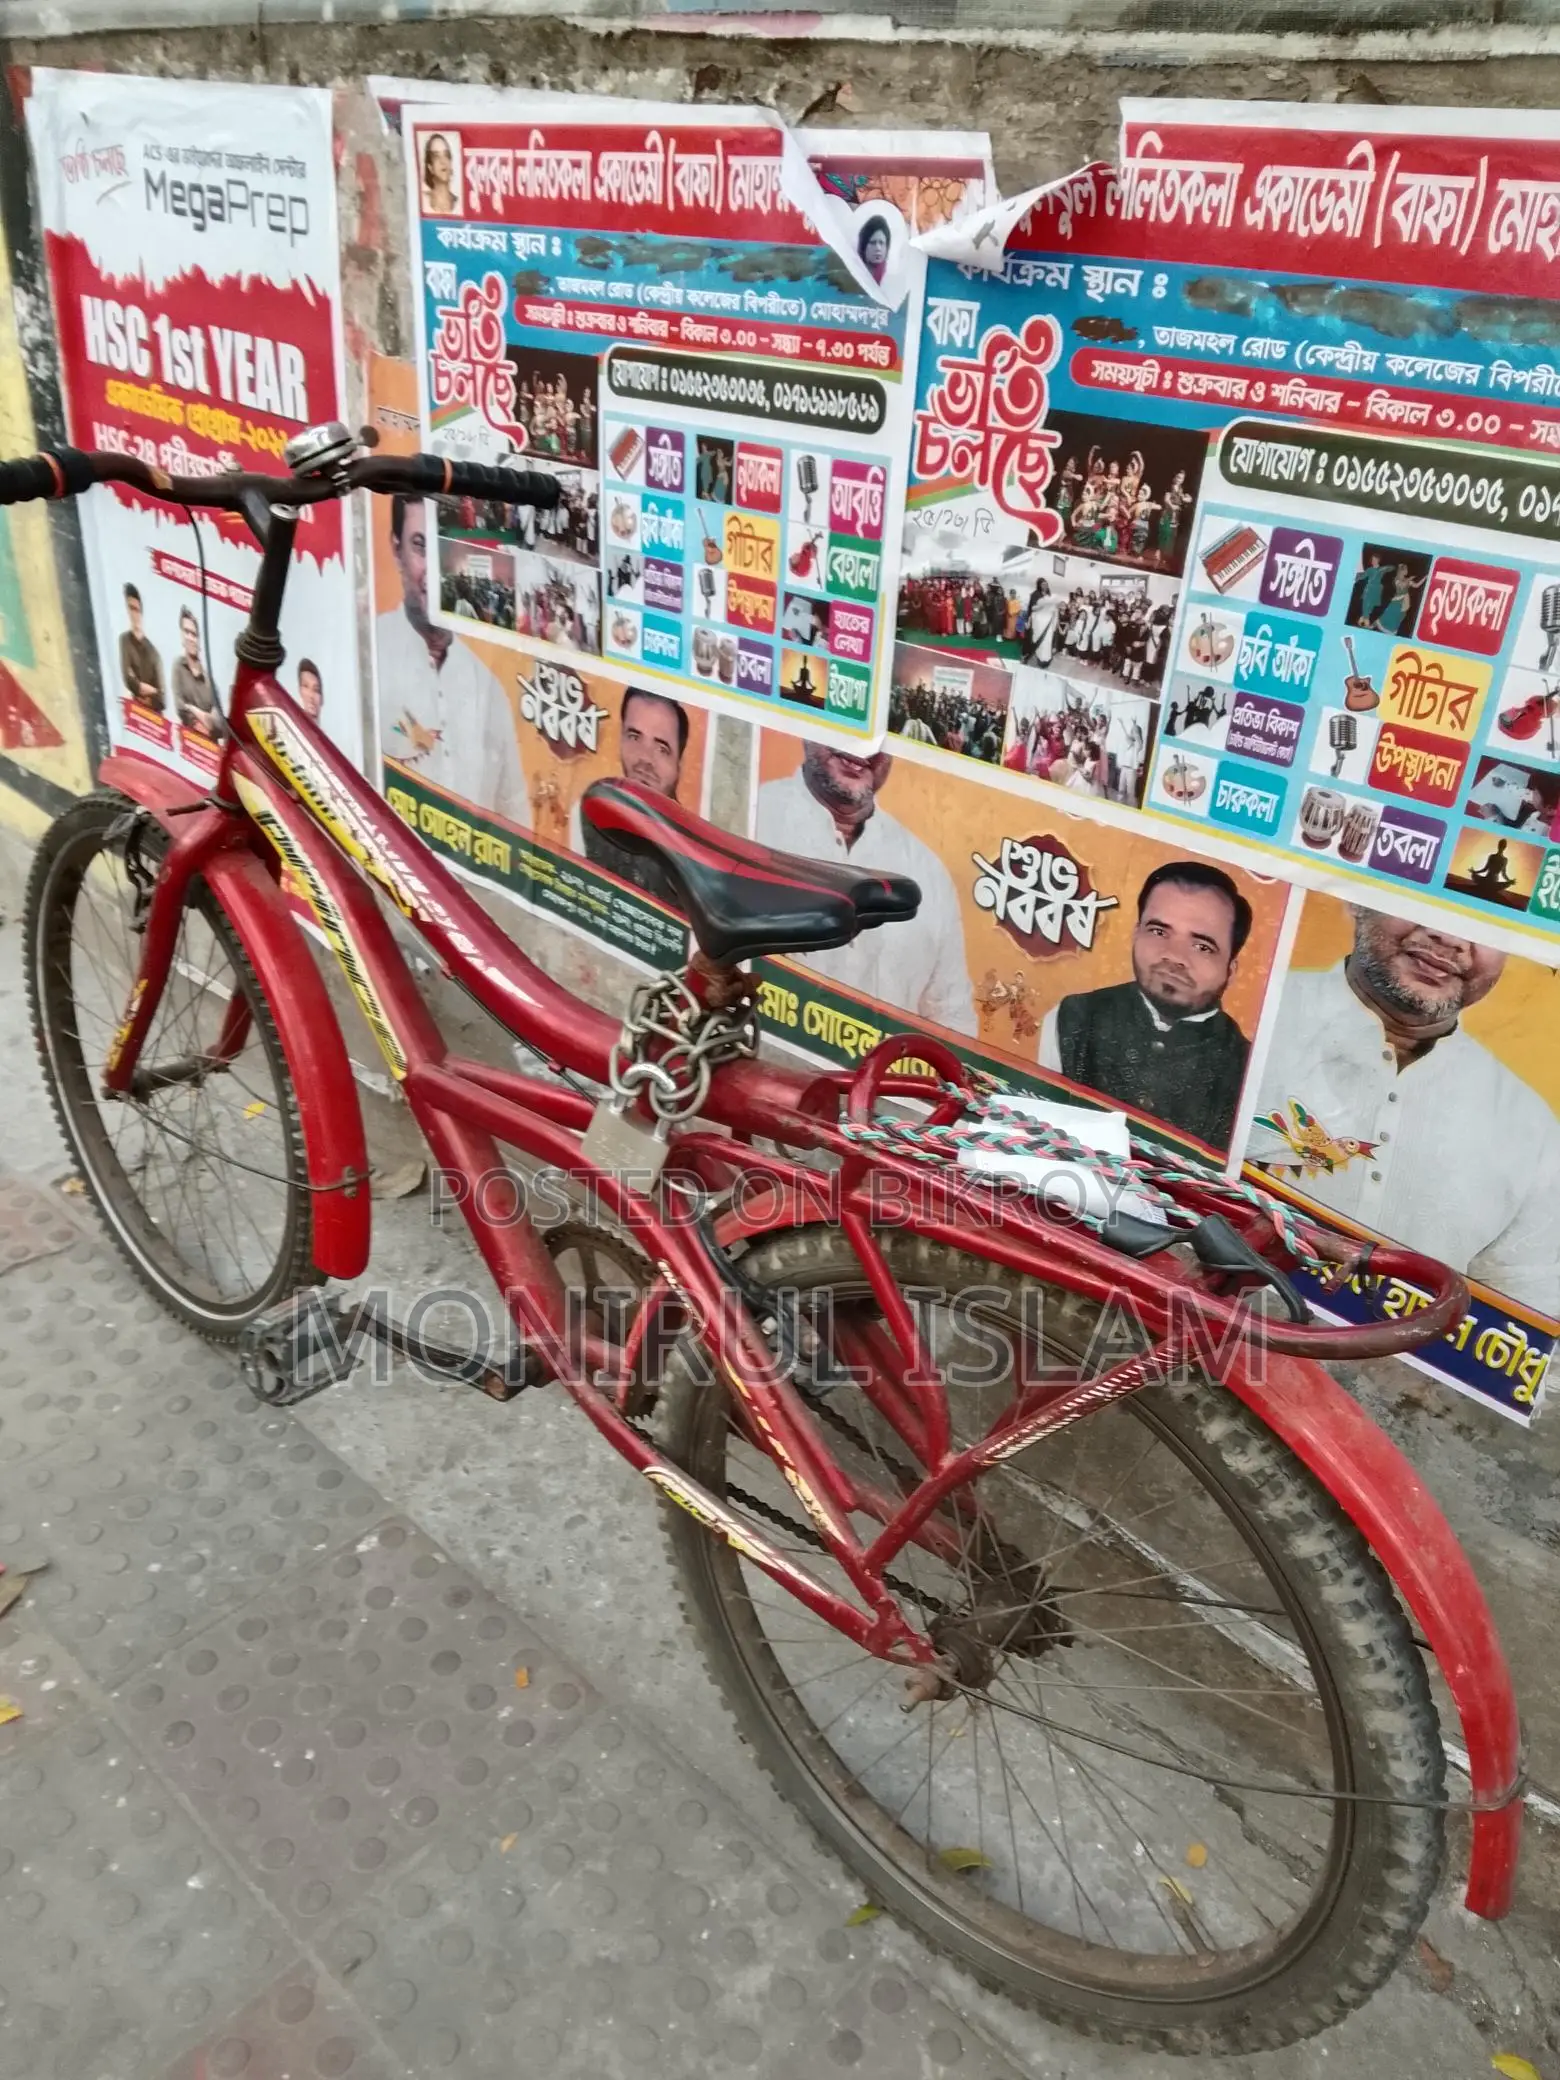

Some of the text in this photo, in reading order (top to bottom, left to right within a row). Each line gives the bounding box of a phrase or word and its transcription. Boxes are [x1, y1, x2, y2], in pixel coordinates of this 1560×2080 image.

[143, 167, 310, 248] MegaPrep
[1244, 138, 1377, 239] একাডেমী
[1373, 149, 1489, 257] (বাফা)
[1081, 263, 1144, 303] স্থান
[926, 296, 981, 350] বাফা
[1152, 325, 1239, 356] তাজমহল
[1242, 335, 1291, 361] রোড
[1385, 352, 1485, 387] কলেজের
[80, 293, 310, 424] HSC 1st YEAR
[929, 315, 1062, 432] ভর্তি
[1270, 376, 1344, 414] শনিবার
[1364, 388, 1434, 426] বিকাল
[1434, 407, 1502, 435] ৩.০০
[914, 410, 1063, 547] চলছে
[1228, 436, 1316, 485] যোগাযোগ
[1333, 453, 1509, 523] ০১৫৫২৩৫৩০৩৫,
[1269, 537, 1334, 608] সঙ্গীত
[1428, 570, 1515, 637] নৃত্যকলা
[1237, 623, 1318, 688] ছবি আঁকা
[1388, 650, 1480, 732] গীটার
[1375, 732, 1462, 793] উপস্থাপনা
[1215, 778, 1281, 824] চারুকলা
[1001, 836, 1081, 900] শুভ
[1376, 821, 1441, 871] তবলা
